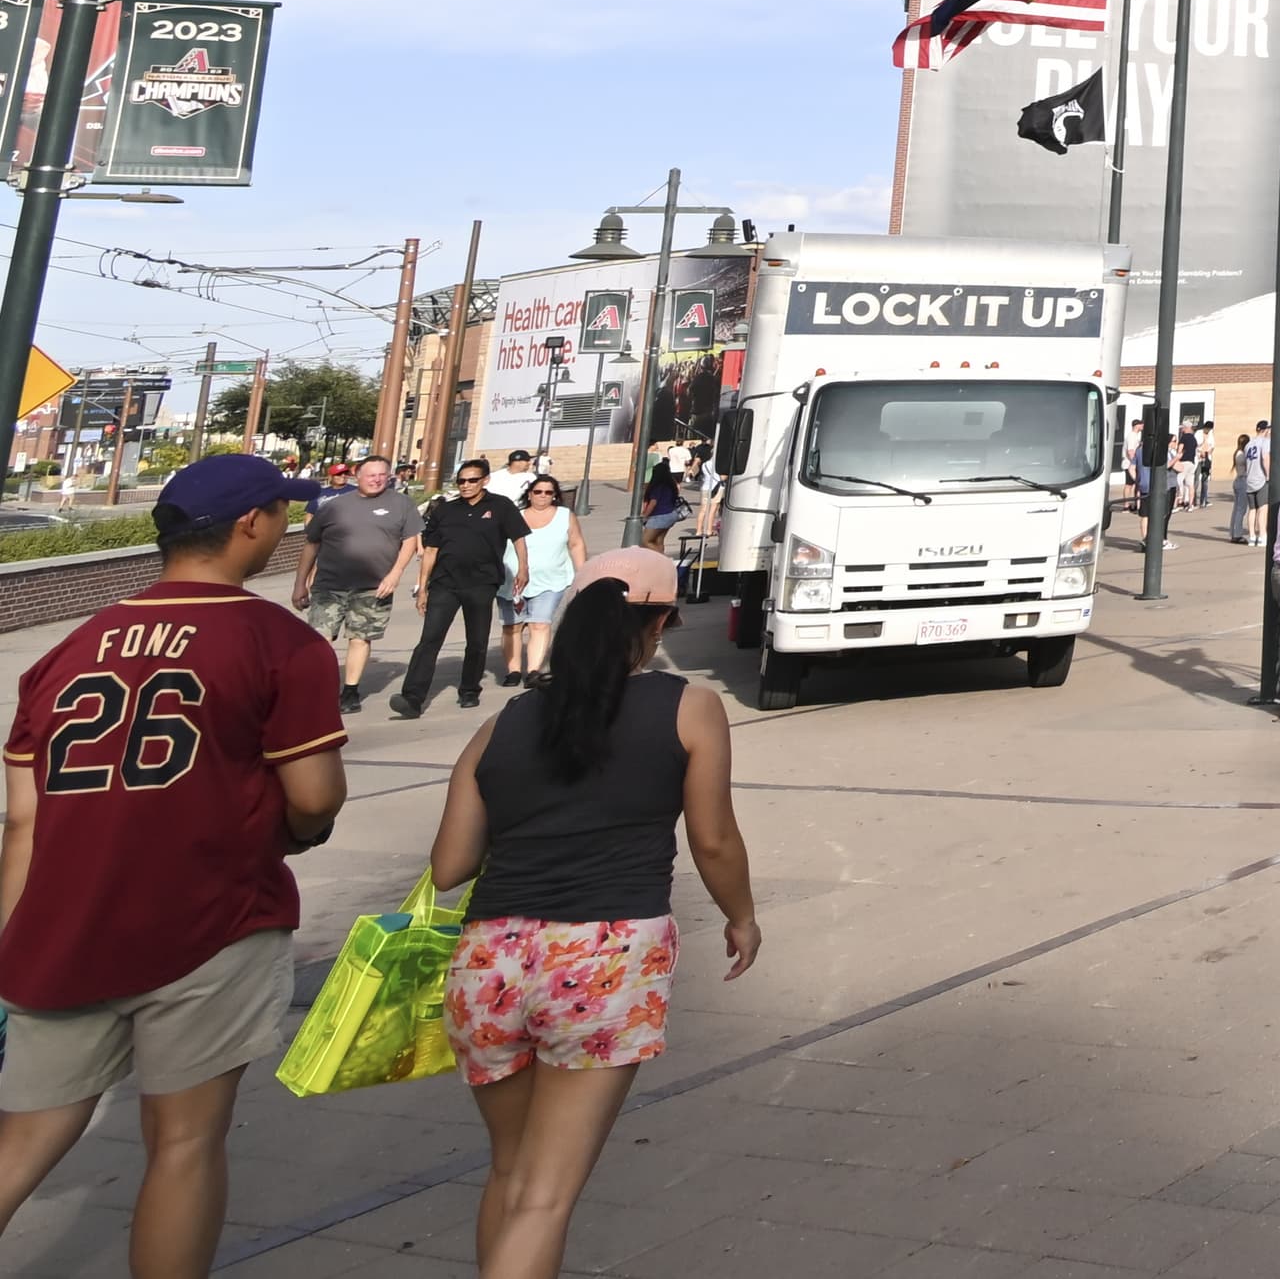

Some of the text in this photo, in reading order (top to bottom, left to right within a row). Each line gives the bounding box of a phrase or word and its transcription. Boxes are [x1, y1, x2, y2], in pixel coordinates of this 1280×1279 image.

[150, 20, 243, 43] 2023
[131, 80, 243, 106] CHAMPIONS
[502, 296, 550, 333] Health
[812, 292, 1084, 328] LOCK IT UP
[497, 335, 576, 371] hits hoe.
[918, 544, 983, 557] ISUZU
[96, 622, 198, 664] FONG
[920, 623, 967, 638] R70 369
[44, 668, 206, 795] 26
